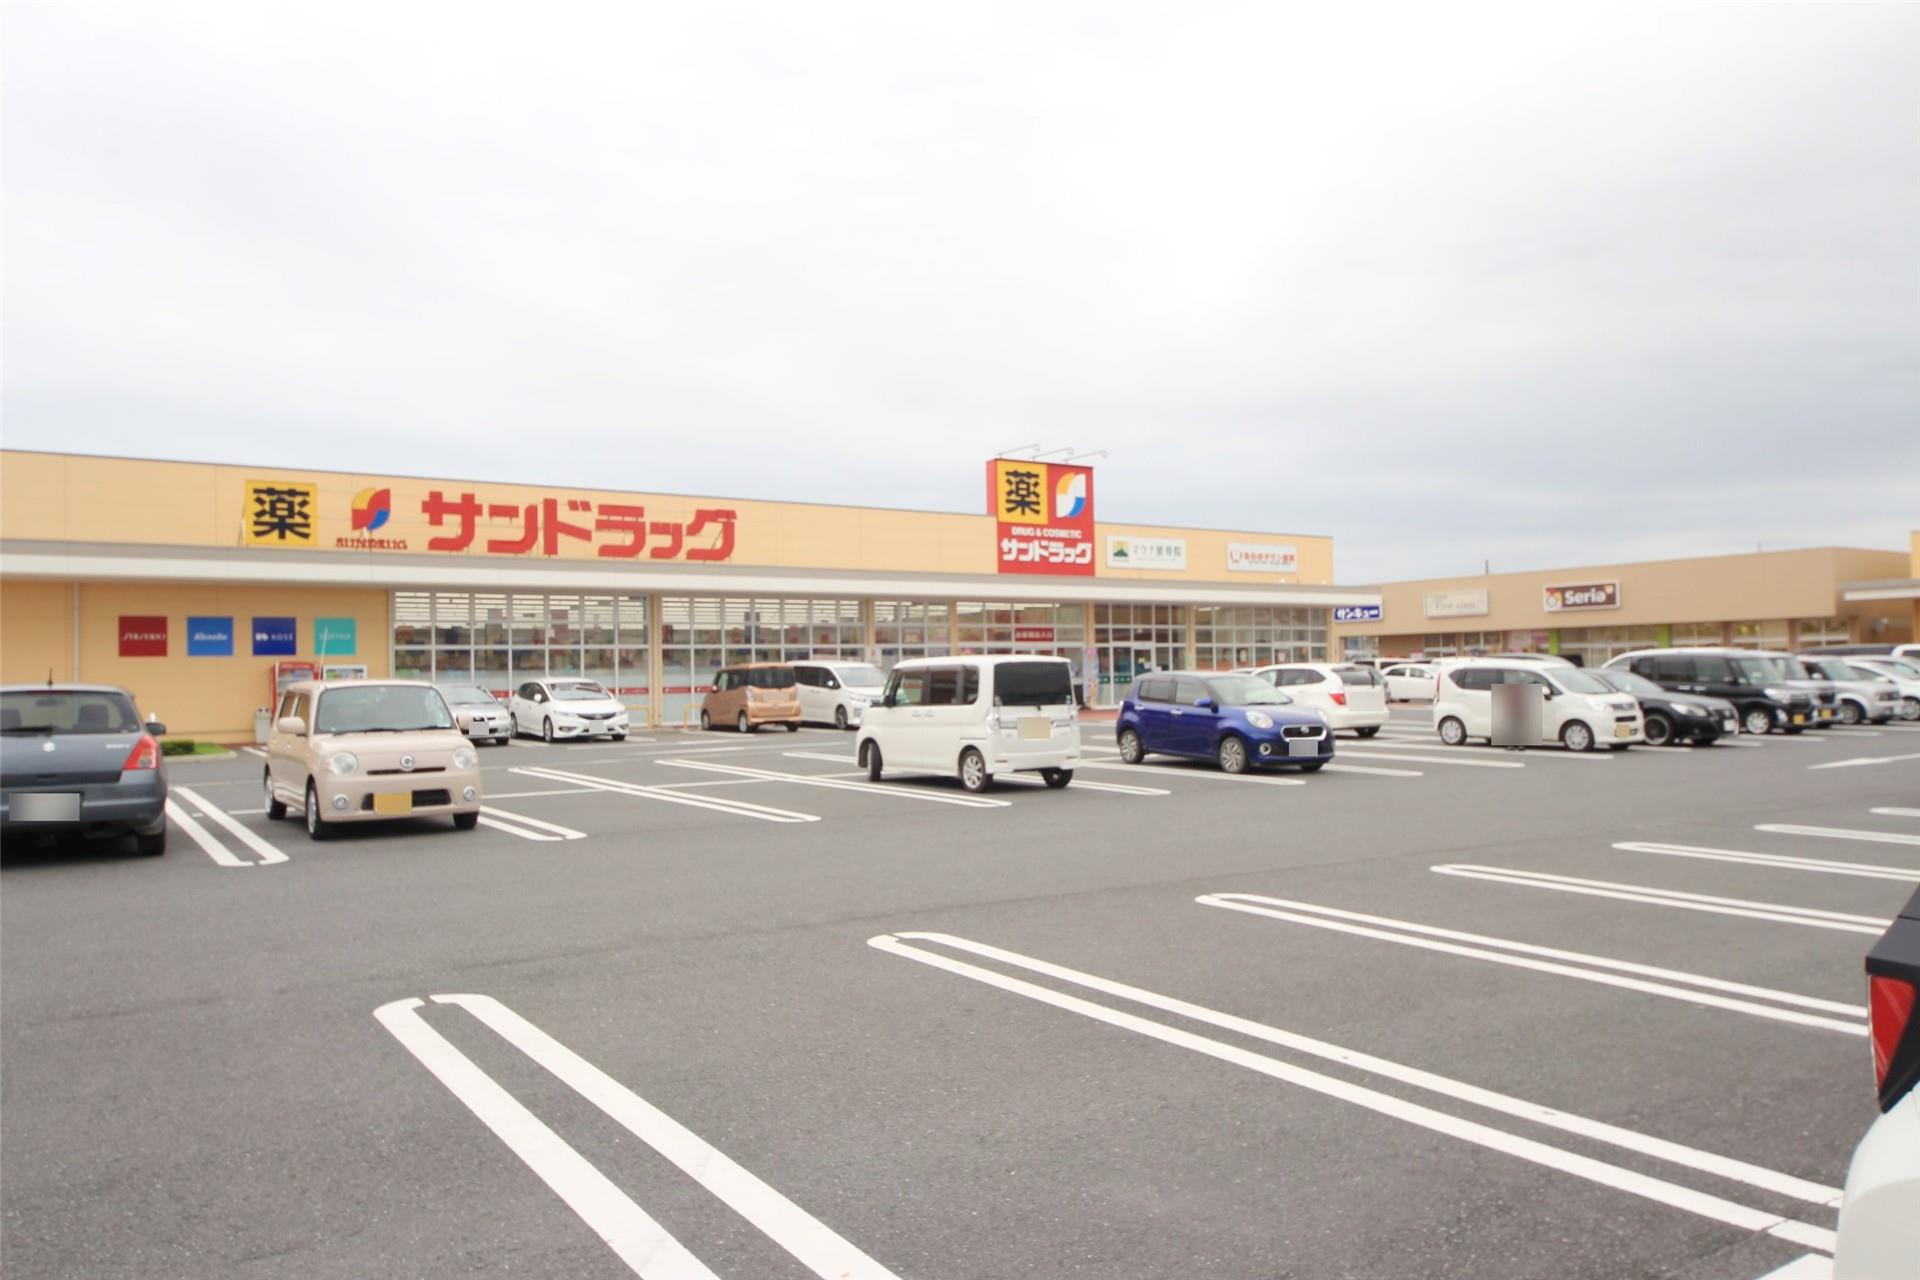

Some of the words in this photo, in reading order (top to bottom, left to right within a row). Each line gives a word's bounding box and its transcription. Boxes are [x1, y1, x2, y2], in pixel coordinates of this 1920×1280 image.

[1004, 470, 1040, 516] 薬
[252, 487, 311, 540] 薬
[421, 490, 737, 561] サンドラッグ
[335, 537, 408, 550] SUNDRUG
[1011, 526, 1035, 537] DRUG
[1042, 527, 1083, 539] COSMETIC
[1000, 538, 1093, 564] サンドラッグ
